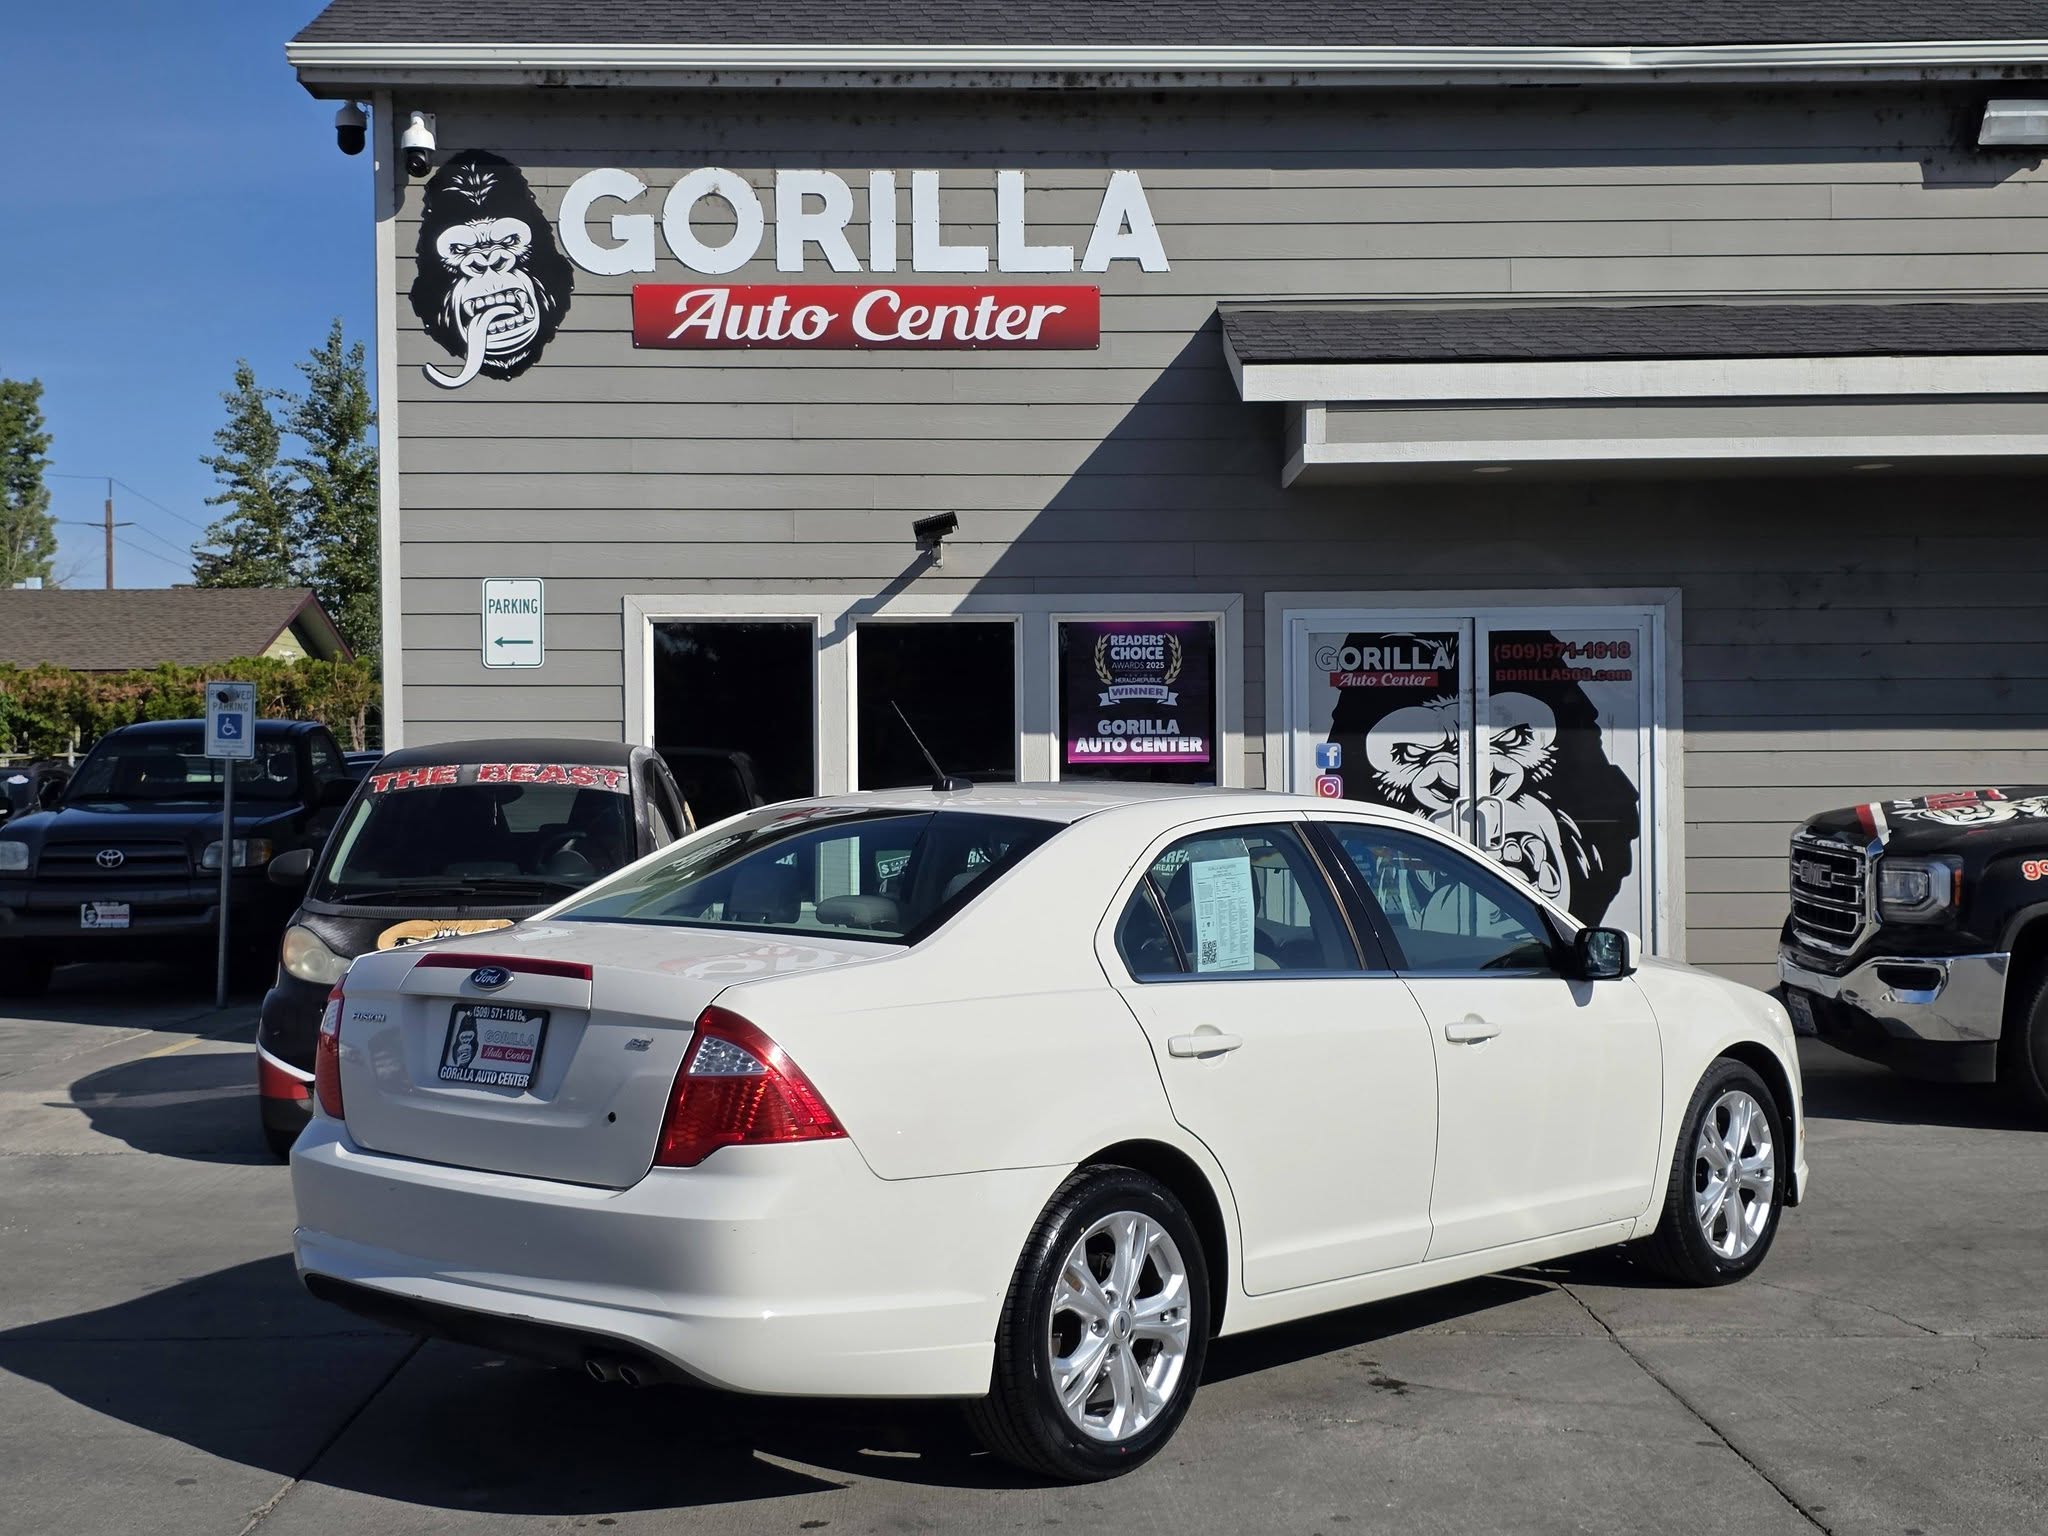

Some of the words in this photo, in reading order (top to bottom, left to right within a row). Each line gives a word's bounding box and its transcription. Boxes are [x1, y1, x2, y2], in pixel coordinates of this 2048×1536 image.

[558, 167, 1172, 275] GORILLA
[667, 288, 838, 342] Auto
[852, 289, 1066, 341] Center
[488, 598, 538, 614] PARKING
[1111, 635, 1166, 646] READERS'
[1111, 647, 1164, 660] CHOICE
[1315, 645, 1452, 672] GORILLA
[1339, 673, 1377, 686] Auto
[1381, 673, 1431, 686] Center
[1111, 687, 1164, 696] WINNER
[213, 702, 249, 712] PARKING
[1097, 719, 1180, 735] GORILLA
[1075, 737, 1128, 753] AUTO
[1130, 737, 1203, 753] CENTER
[369, 765, 460, 793] THE
[476, 763, 629, 788] BEAST
[475, 969, 500, 984] Ford
[473, 1006, 489, 1018] (509)
[491, 1007, 523, 1021] 571-1818
[485, 1030, 535, 1047] GORILLA
[484, 1047, 503, 1059] Auto
[475, 1070, 498, 1084] AUTO
[498, 1072, 529, 1087] CENTER
